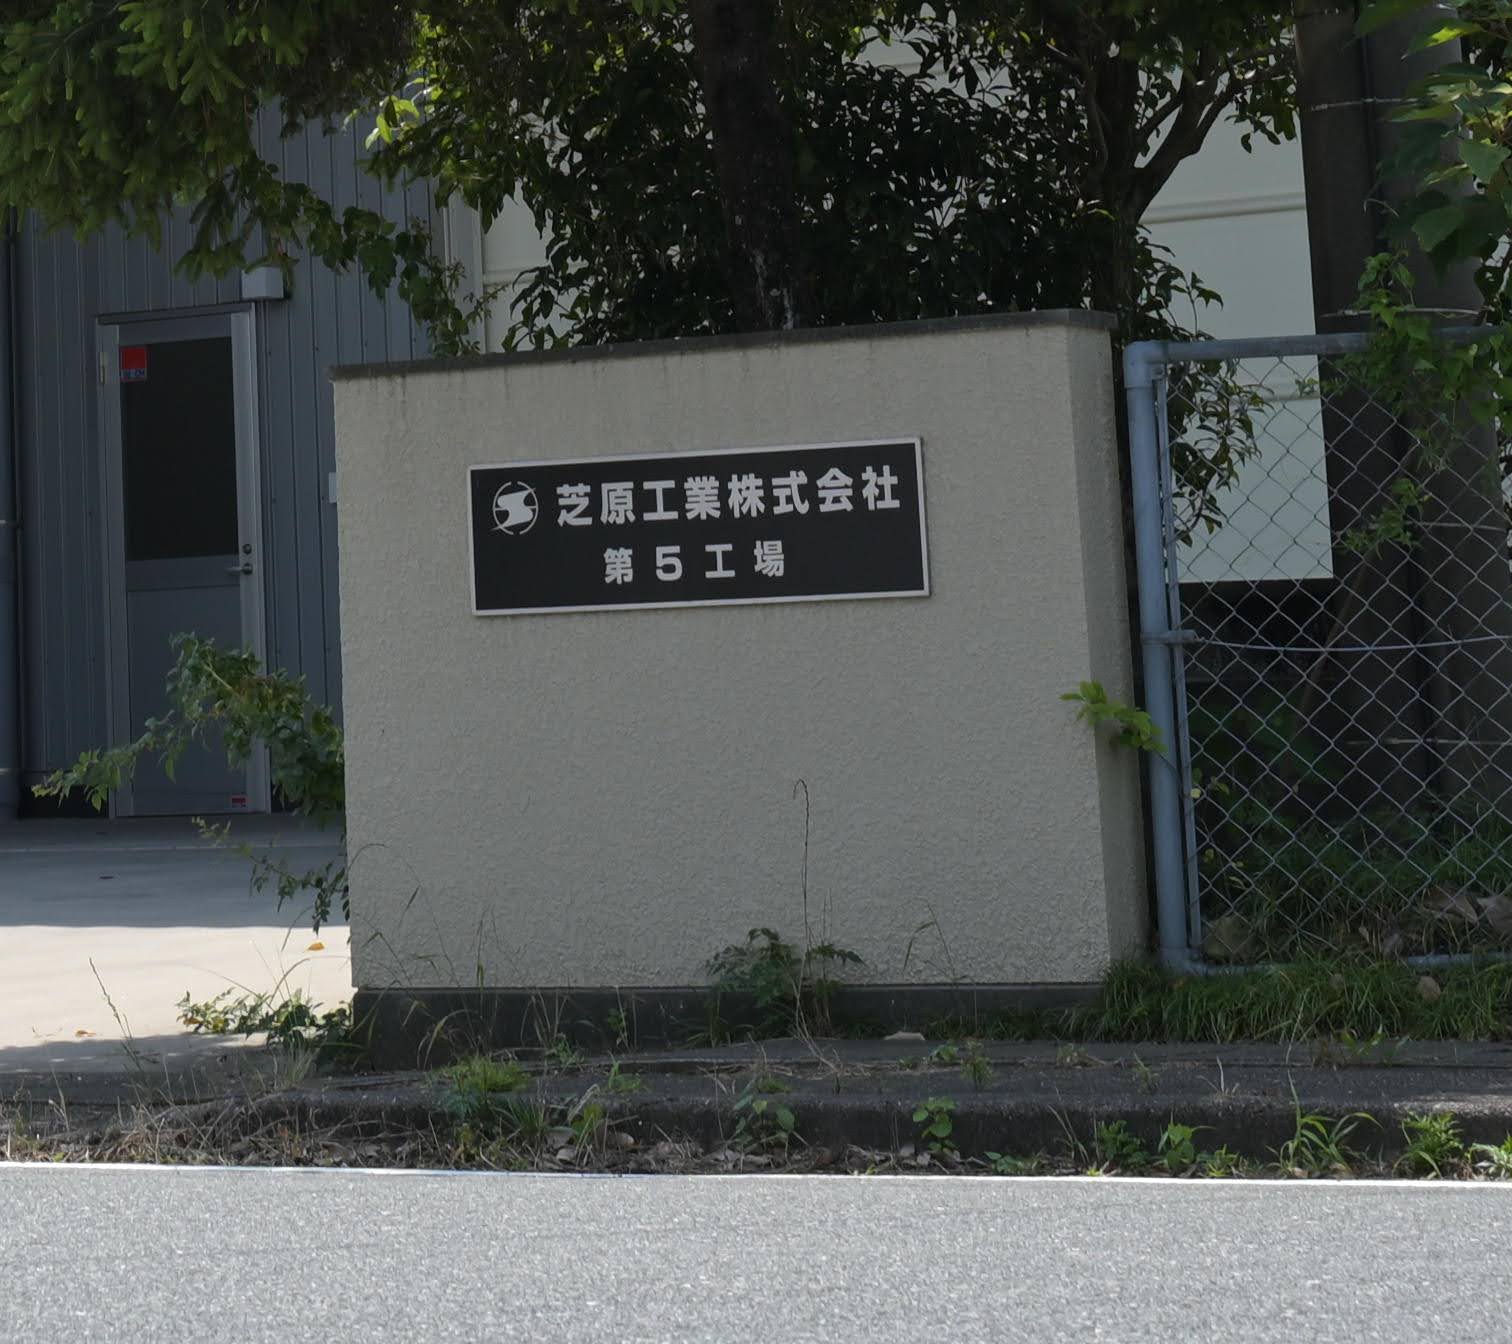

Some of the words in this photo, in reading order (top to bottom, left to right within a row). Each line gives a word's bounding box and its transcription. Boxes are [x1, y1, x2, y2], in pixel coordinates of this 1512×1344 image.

[556, 465, 901, 527] 芝原工業株式会社
[603, 540, 786, 585] 第5工場
